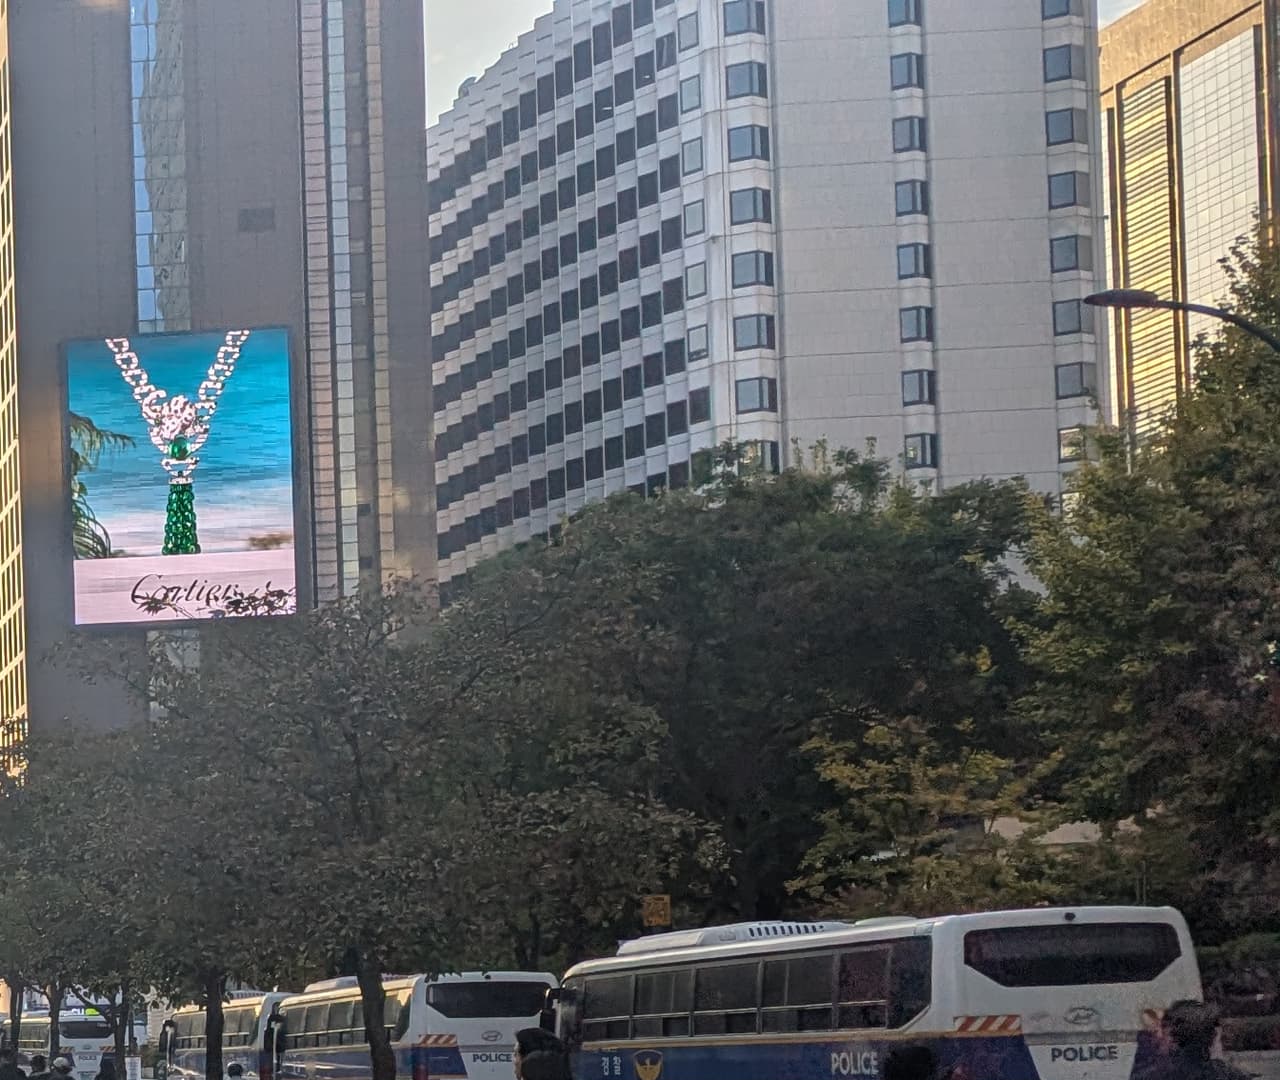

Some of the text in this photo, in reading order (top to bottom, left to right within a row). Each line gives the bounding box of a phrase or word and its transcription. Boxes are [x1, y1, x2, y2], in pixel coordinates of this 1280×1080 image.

[473, 1053, 513, 1063] POLICE
[1051, 1045, 1118, 1062] POLICE
[830, 1052, 880, 1075] POLICE
